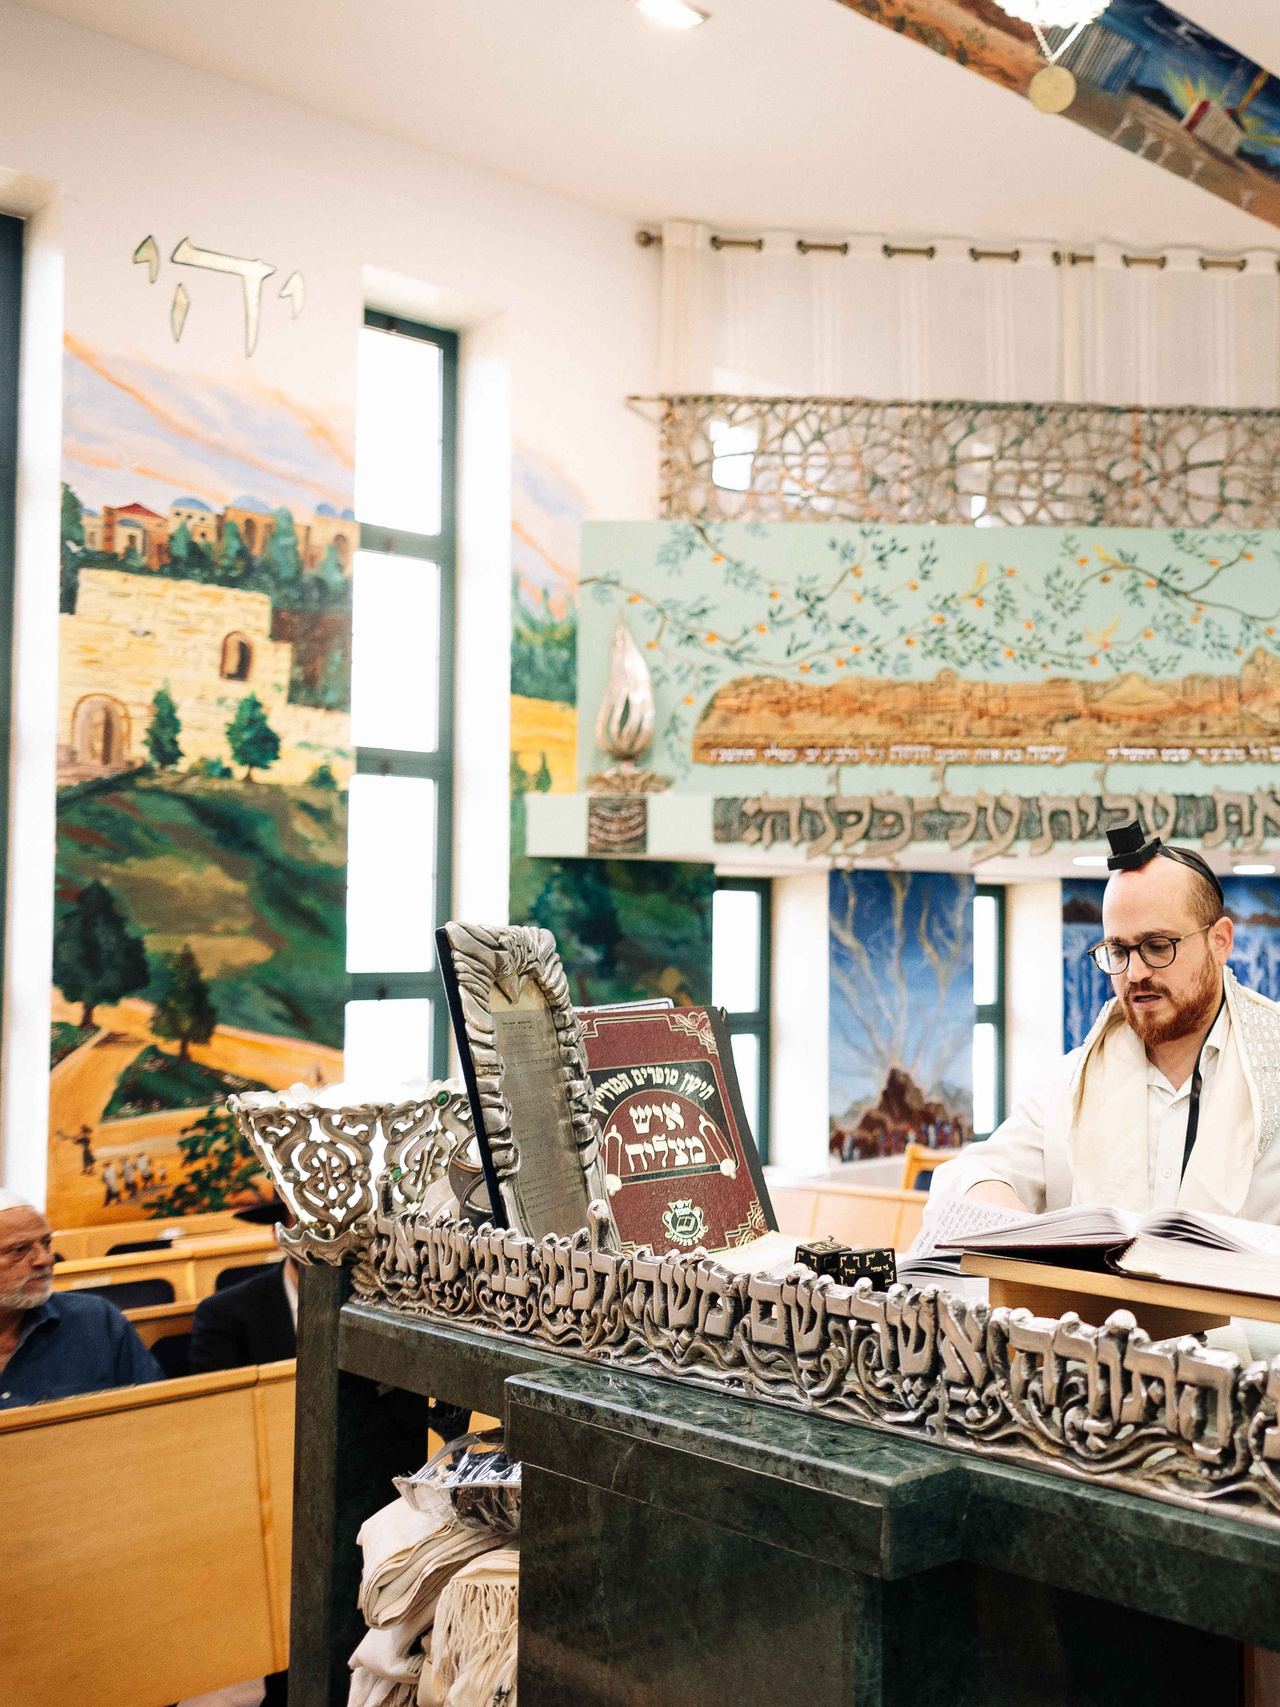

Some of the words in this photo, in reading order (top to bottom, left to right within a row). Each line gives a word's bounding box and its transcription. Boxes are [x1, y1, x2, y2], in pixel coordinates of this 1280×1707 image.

[629, 1101, 685, 1135] איש
[630, 1066, 679, 1087] סופרים
[679, 1072, 715, 1101] תיקון
[625, 1133, 707, 1173] מצליח
[376, 1172, 472, 1284] ישראל
[474, 1222, 533, 1299] בני
[541, 1202, 622, 1313] לפני
[633, 1248, 738, 1340] משה
[749, 1264, 827, 1353] שם
[826, 1279, 991, 1390] אשר
[1008, 1309, 1241, 1464] התורה
